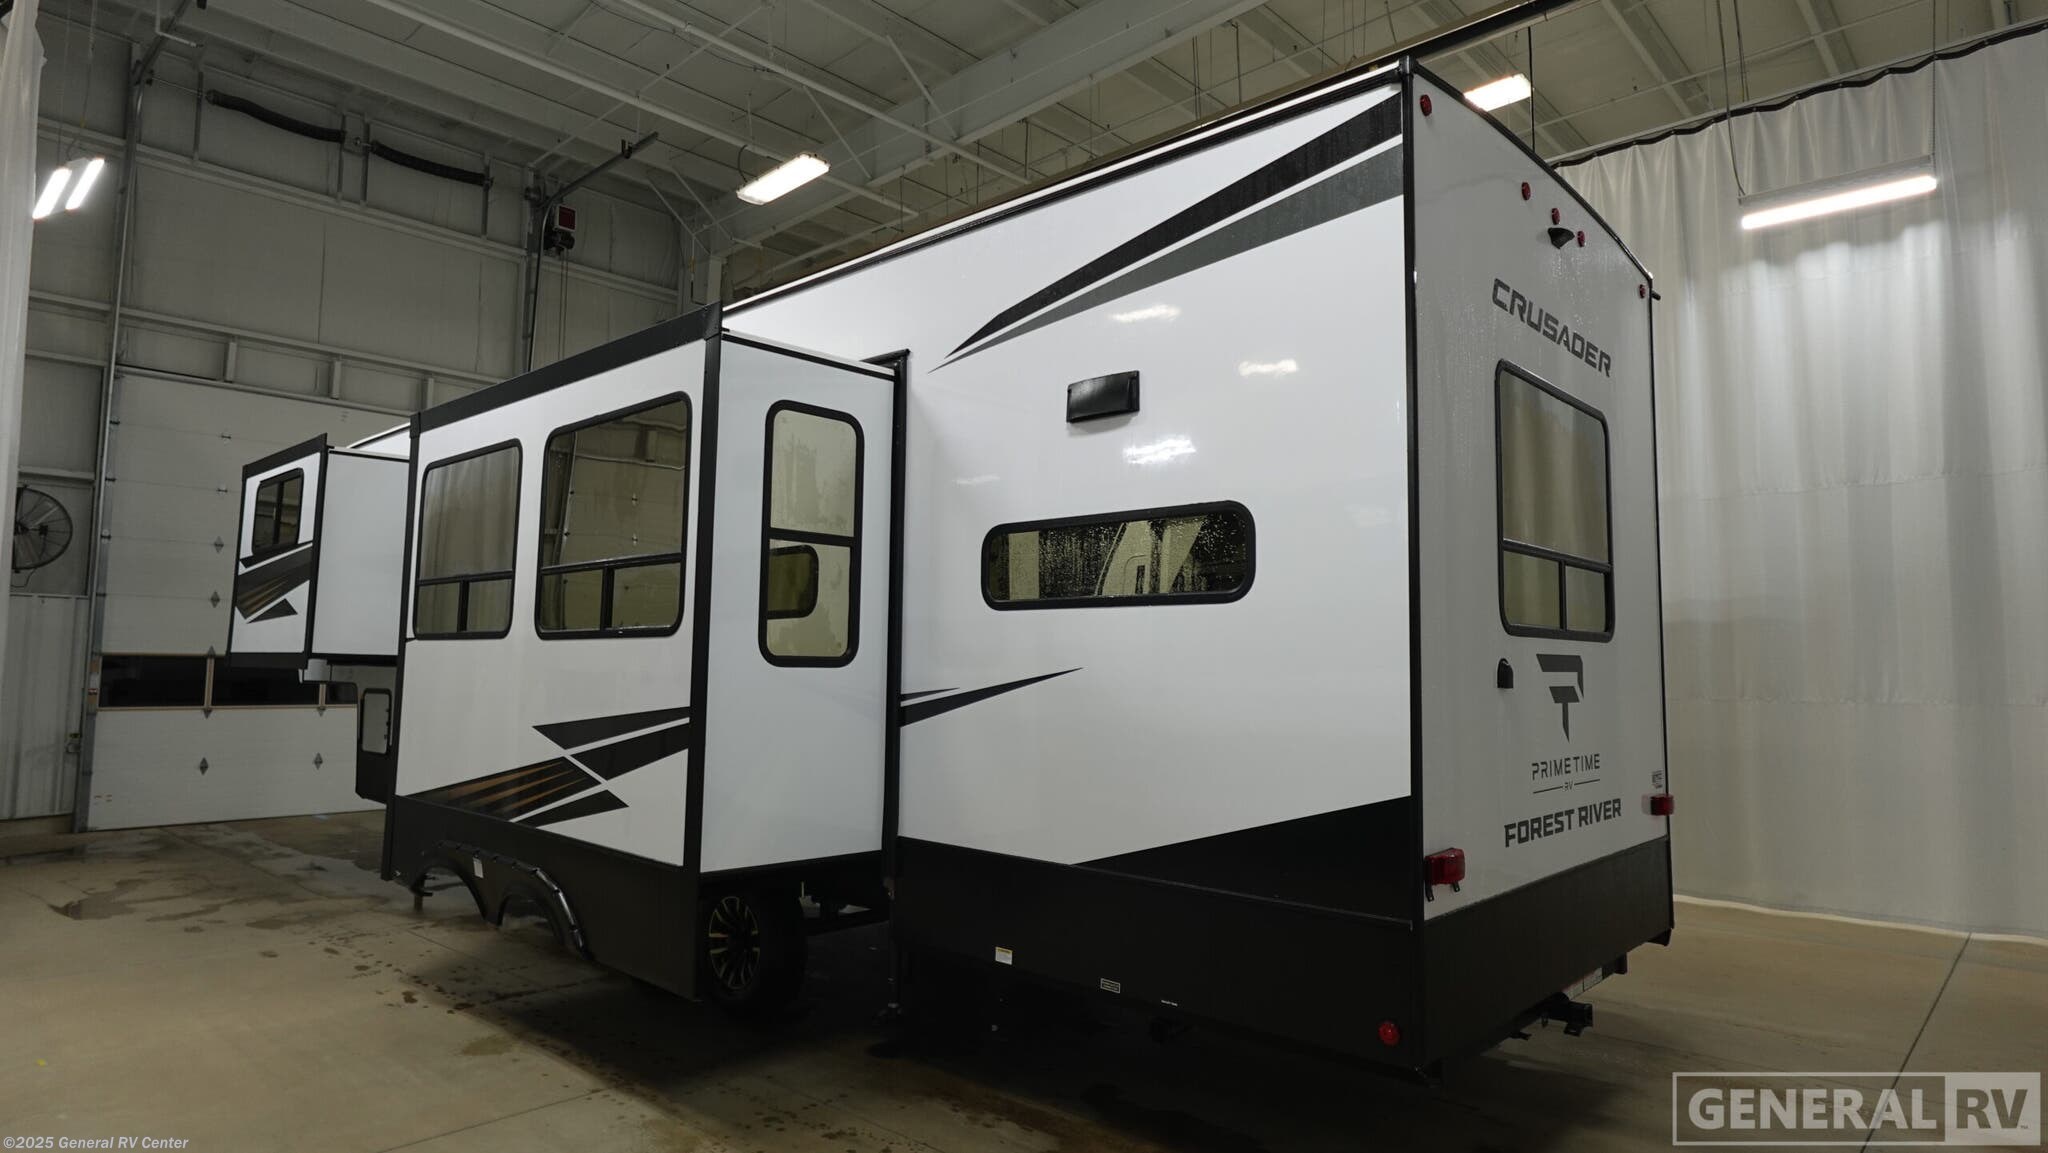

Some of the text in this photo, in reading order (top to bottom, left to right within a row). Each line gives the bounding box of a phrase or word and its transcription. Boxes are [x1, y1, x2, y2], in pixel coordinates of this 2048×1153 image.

[1492, 278, 1611, 377] CRUSADER
[1504, 798, 1622, 848] FOREST RIVER
